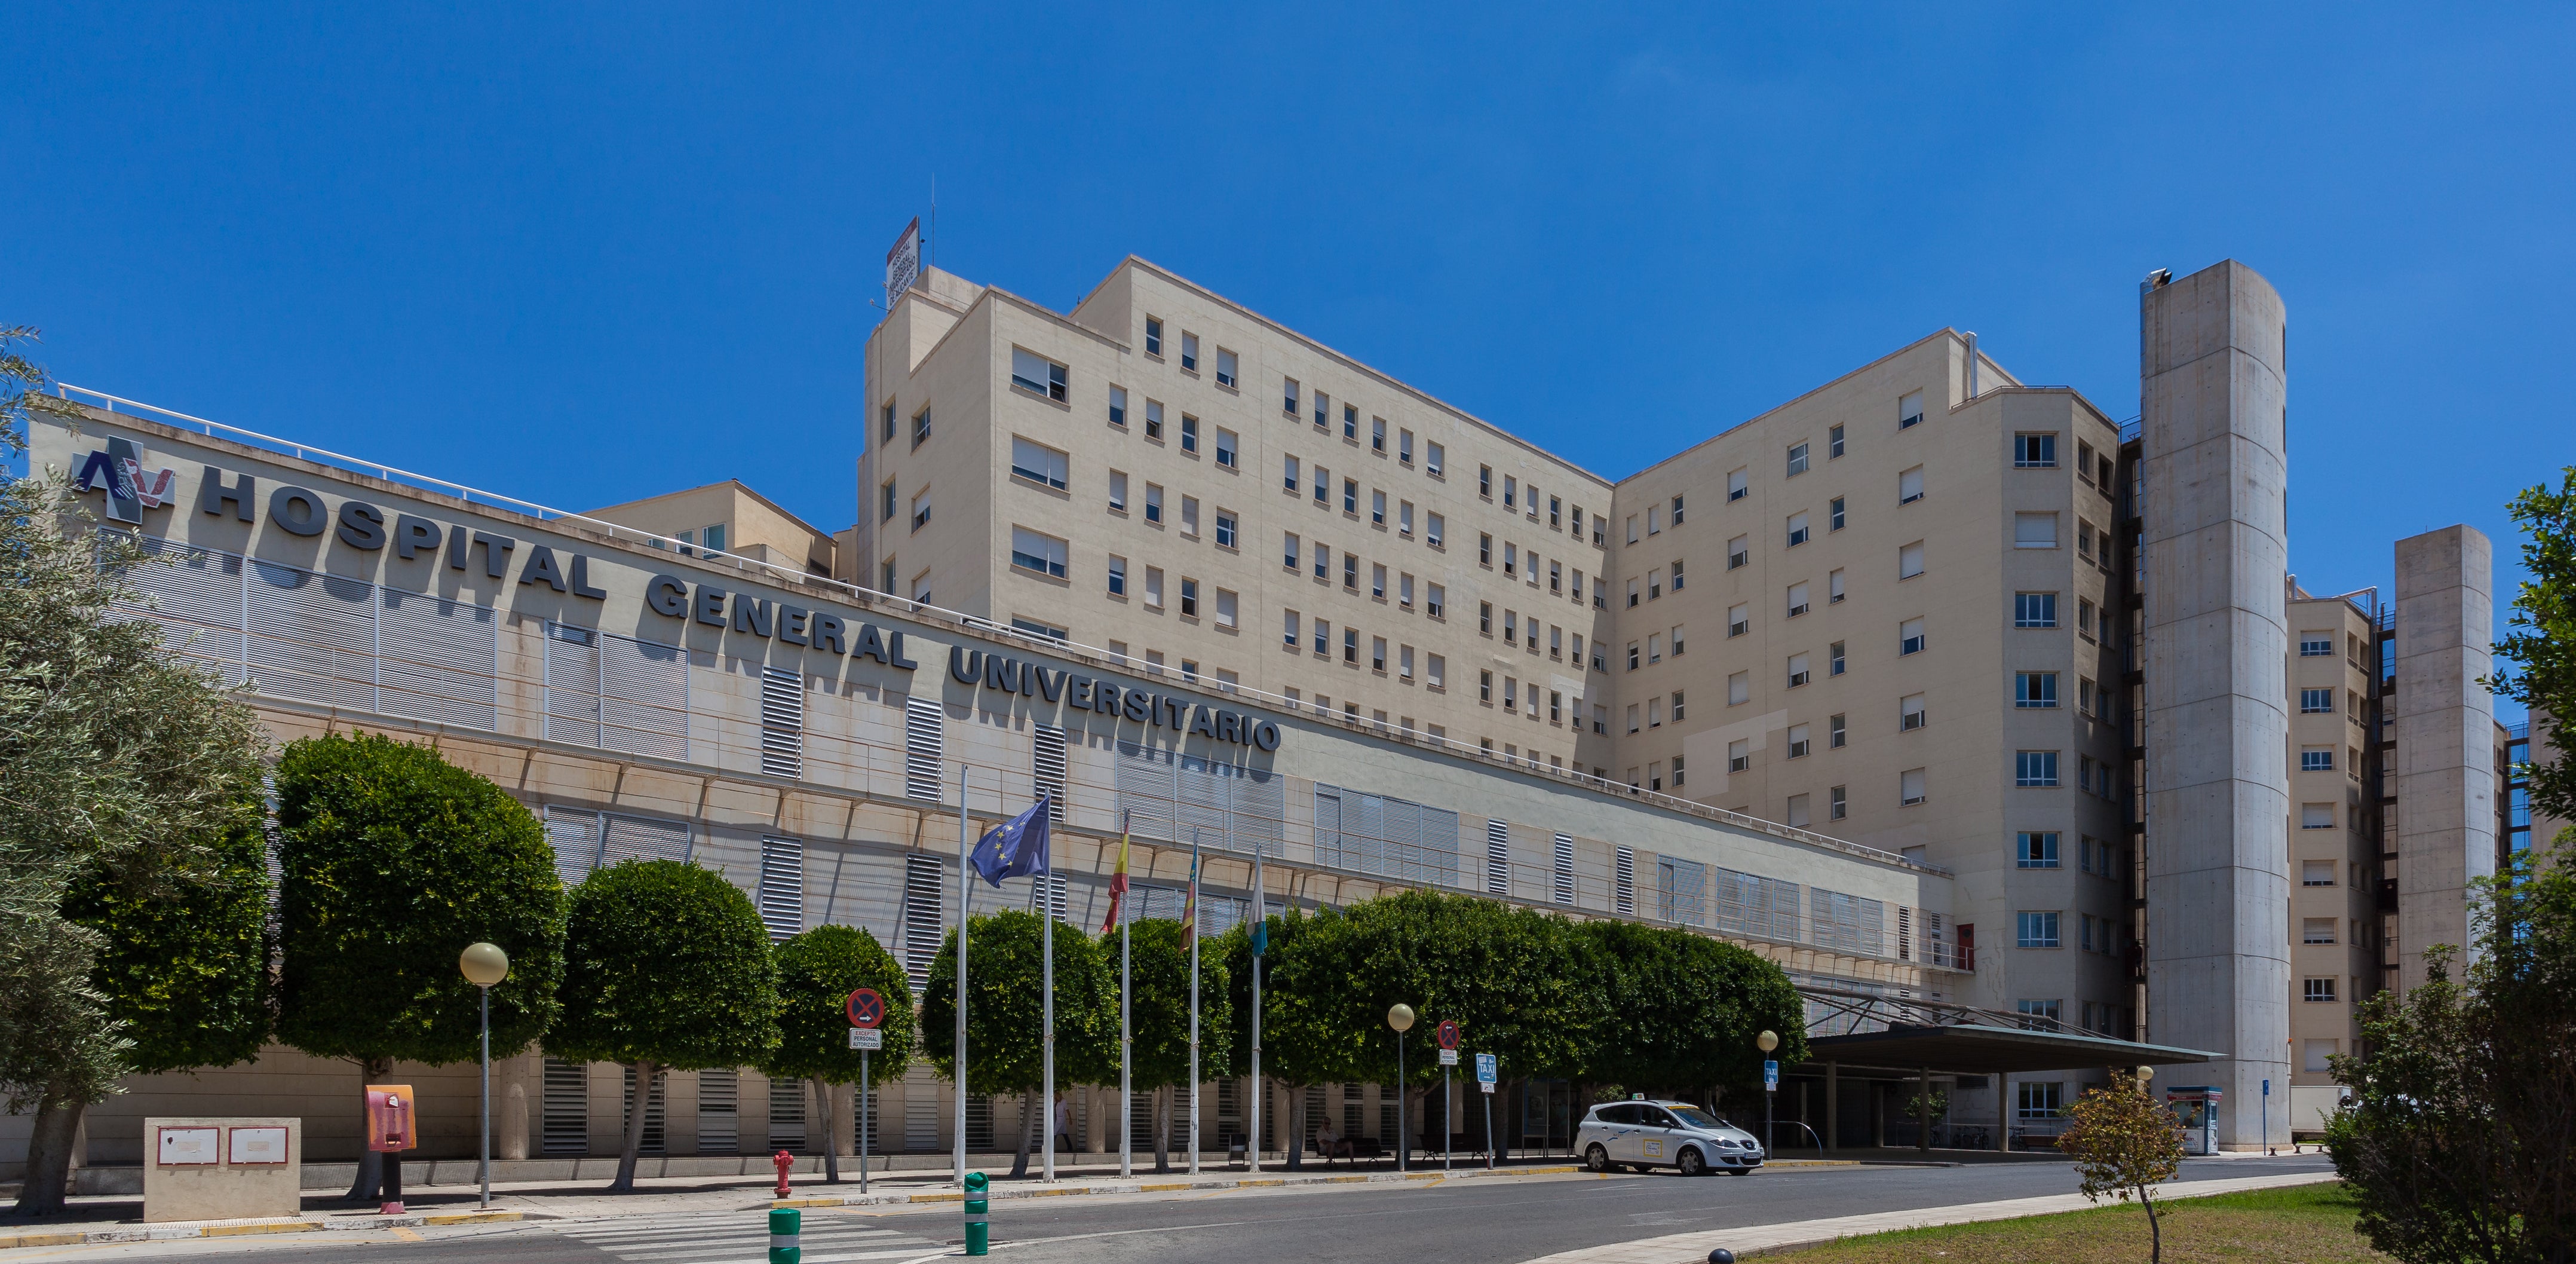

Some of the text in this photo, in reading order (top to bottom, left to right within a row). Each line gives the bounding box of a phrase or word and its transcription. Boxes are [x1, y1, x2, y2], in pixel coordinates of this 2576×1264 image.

[893, 240, 910, 270] HOSPITAL
[893, 252, 910, 280] GENERAL
[203, 465, 1281, 752] HOSPITAL GENERAL UNIVERSITARIO
[1479, 1063, 1495, 1074] TAXI
[1765, 1067, 1777, 1076] TAXI
